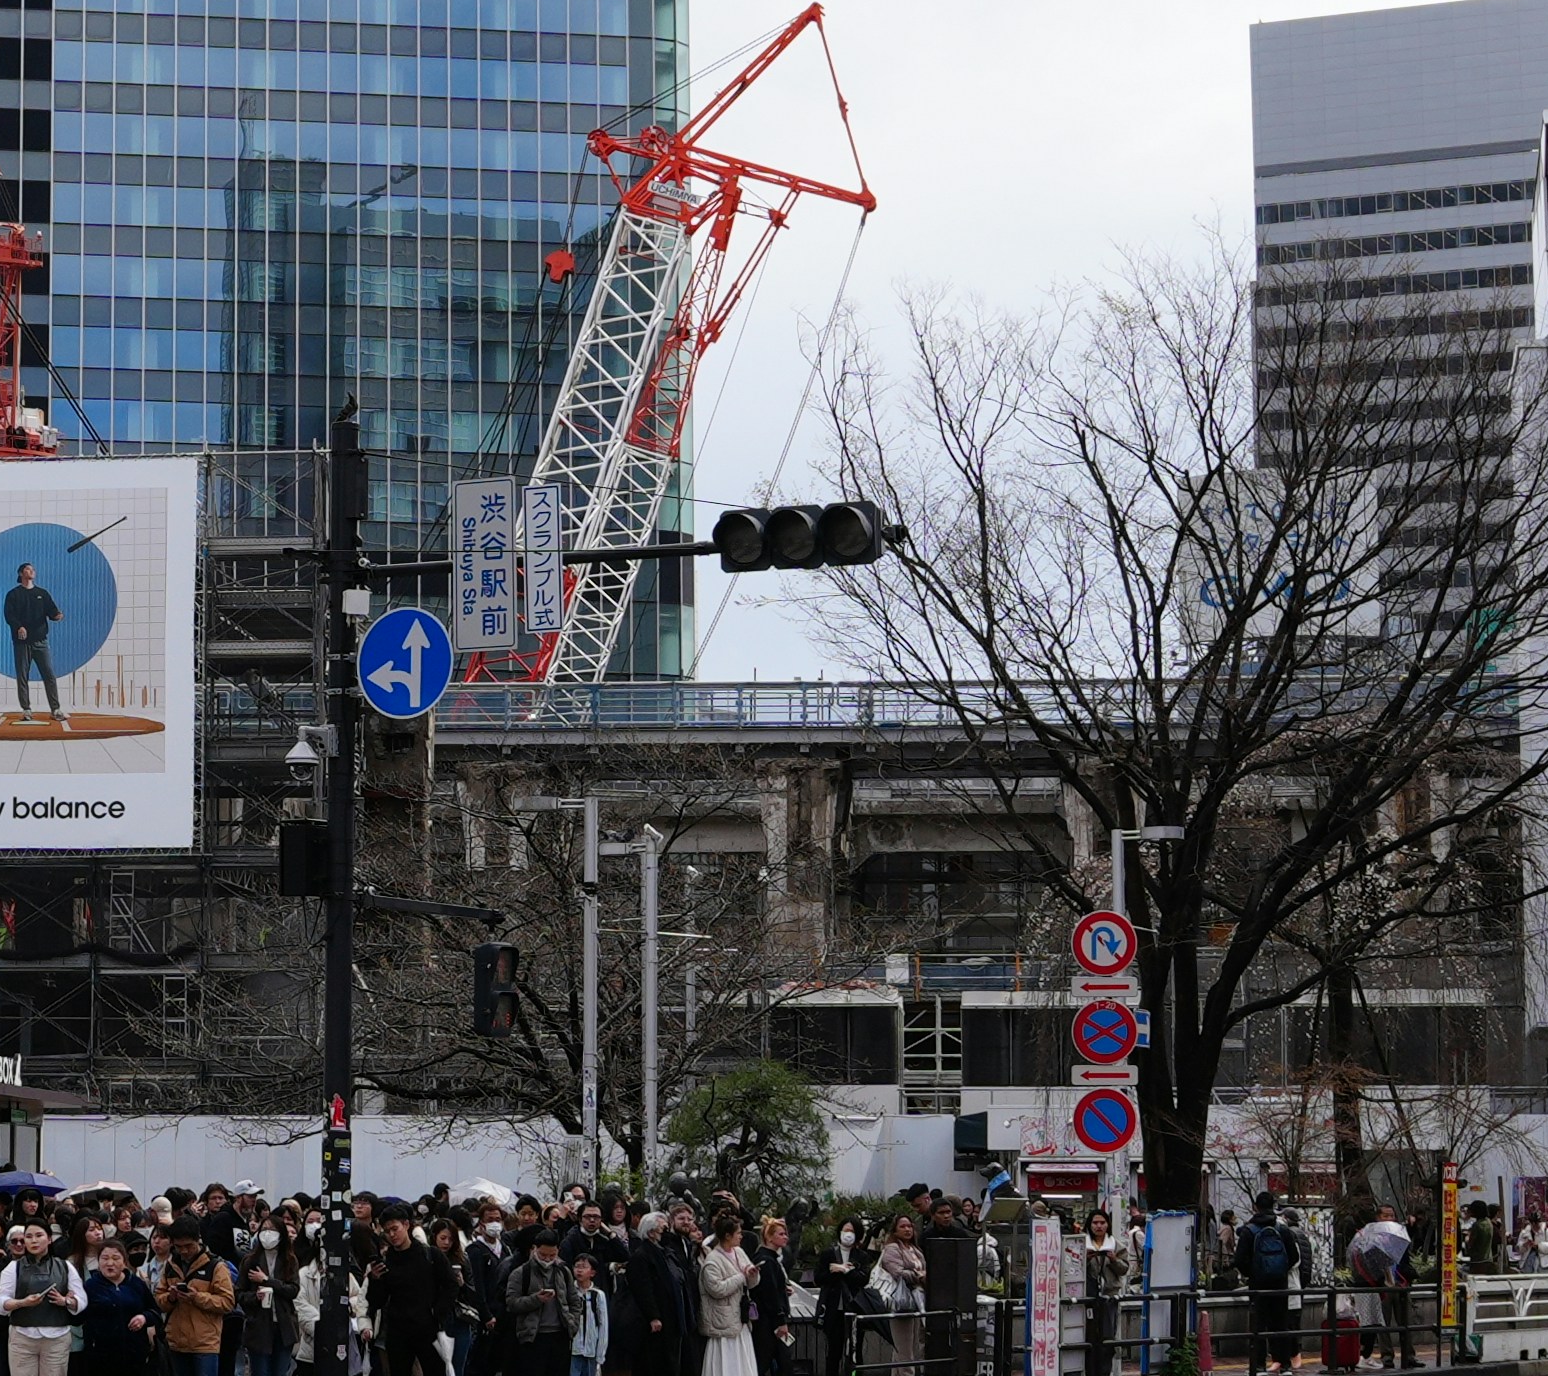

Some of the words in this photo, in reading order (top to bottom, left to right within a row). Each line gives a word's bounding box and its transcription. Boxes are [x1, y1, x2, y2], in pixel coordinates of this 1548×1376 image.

[460, 517, 477, 582] Shibuya
[480, 492, 508, 636] 渋谷駅前
[532, 492, 554, 626] スクランブル式
[462, 588, 477, 622] Sta.
[12, 796, 126, 819] balance
[0, 1055, 14, 1085] BOX
